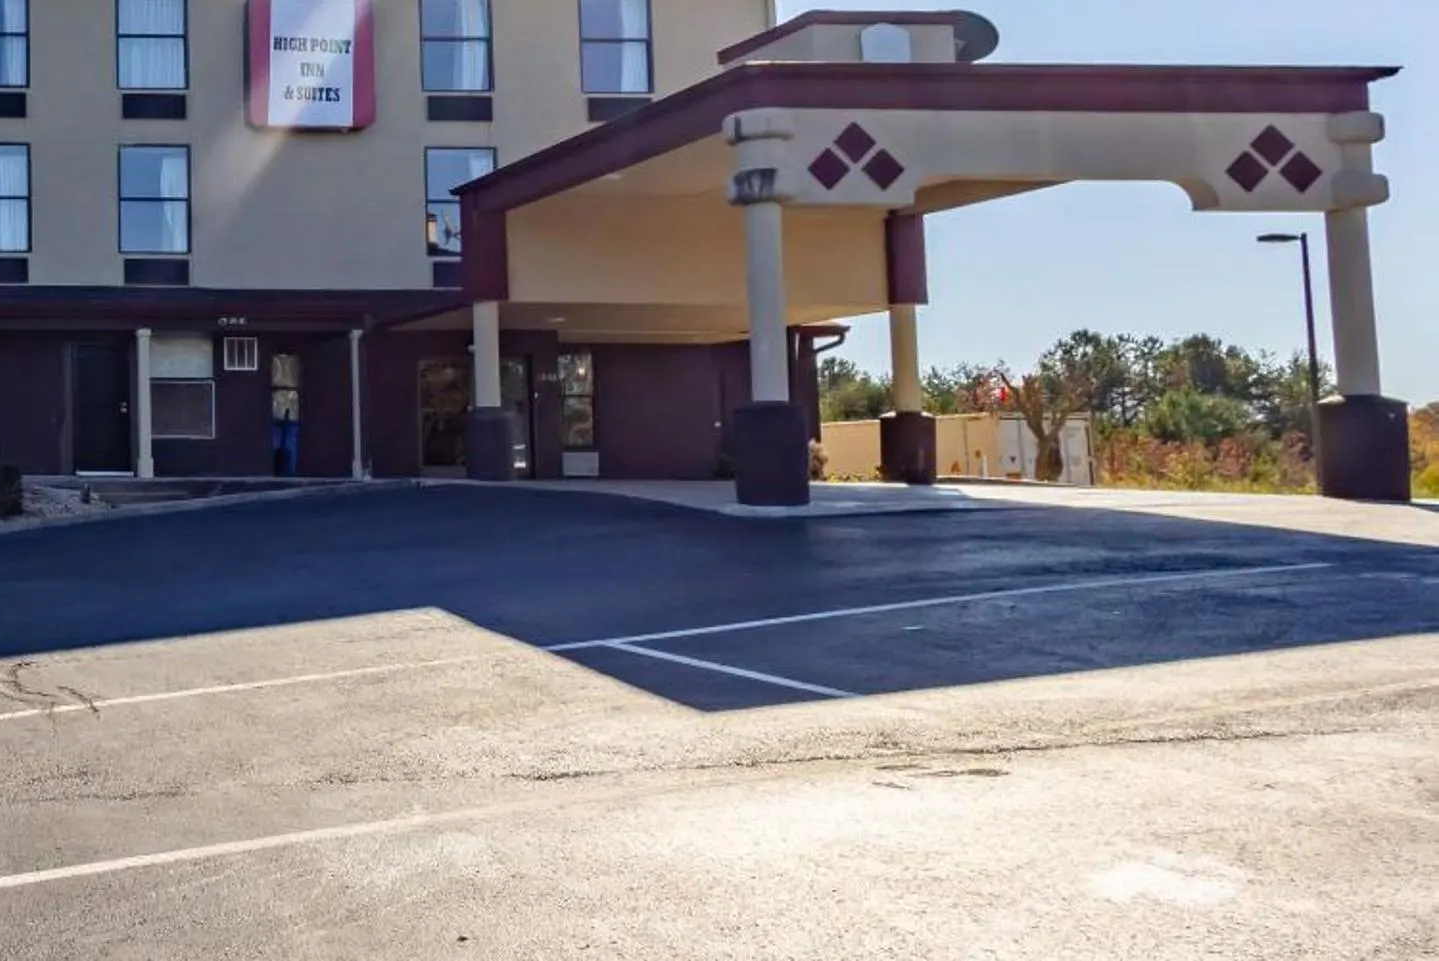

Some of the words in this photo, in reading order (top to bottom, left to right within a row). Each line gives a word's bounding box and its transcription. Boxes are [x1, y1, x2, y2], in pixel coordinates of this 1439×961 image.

[273, 36, 308, 52] HIGH
[310, 37, 352, 54] POINT
[300, 62, 325, 77] INN
[284, 85, 294, 100] &
[297, 86, 340, 102] SUITES
